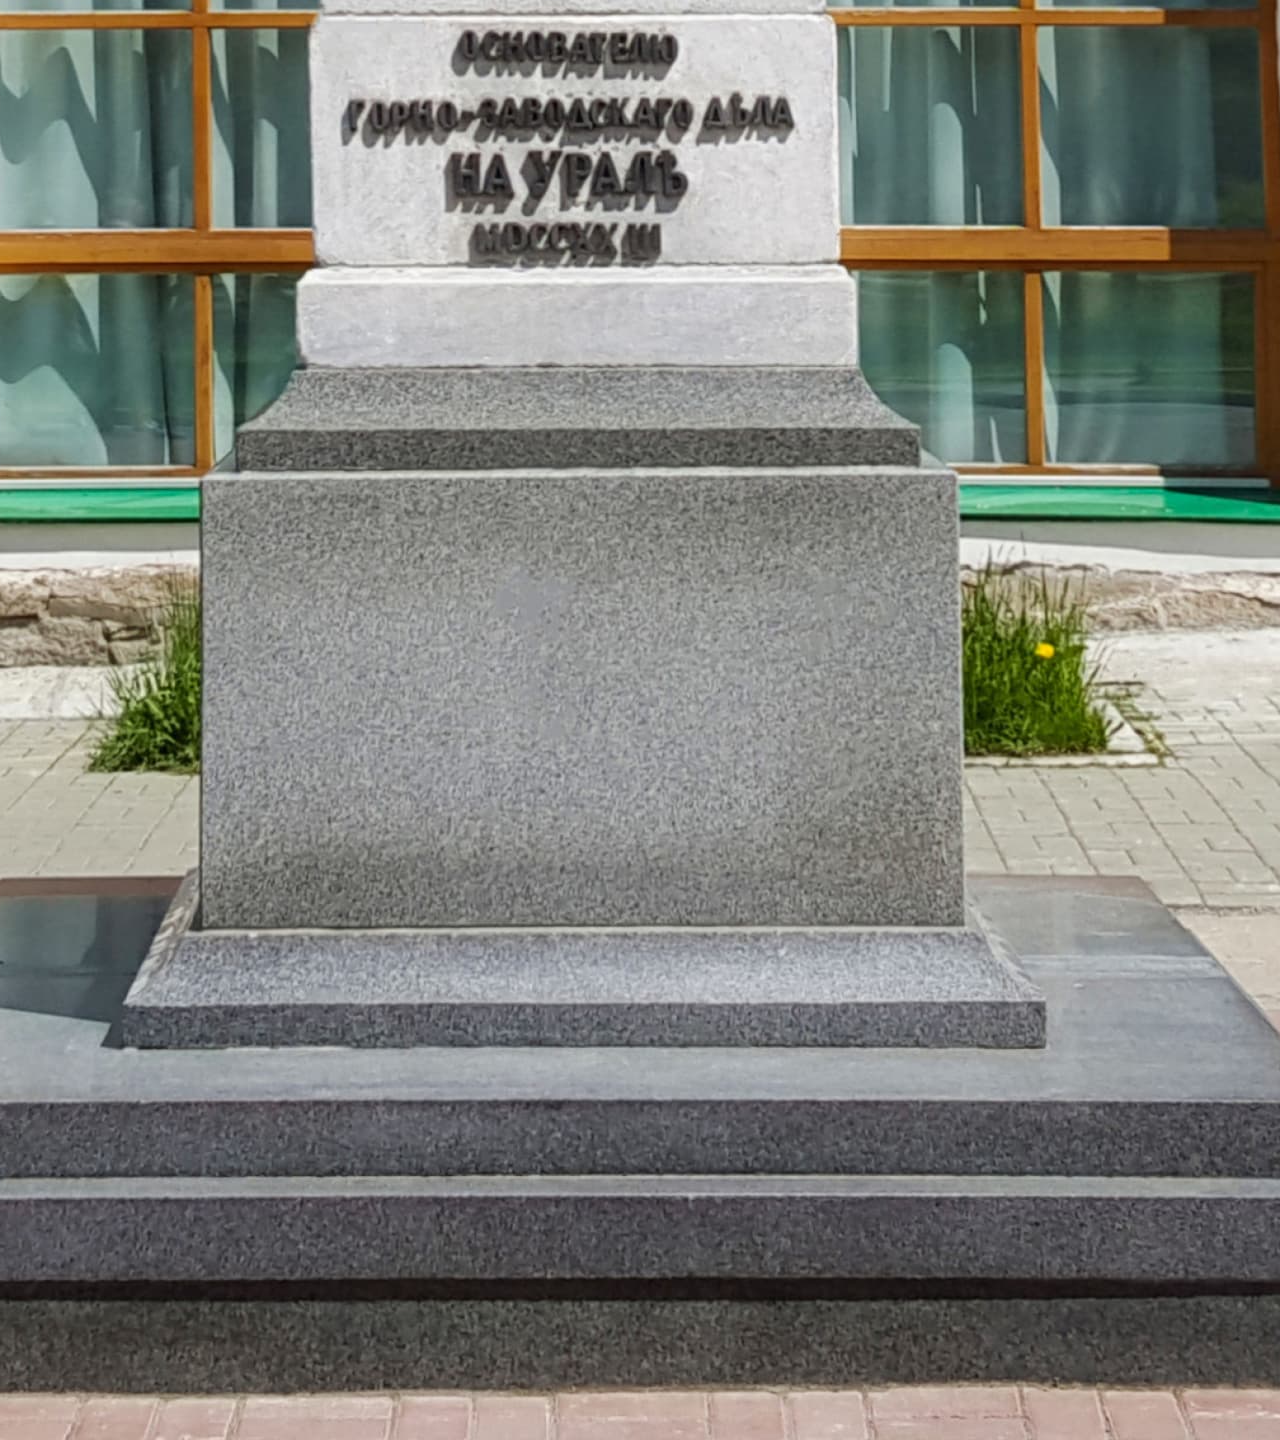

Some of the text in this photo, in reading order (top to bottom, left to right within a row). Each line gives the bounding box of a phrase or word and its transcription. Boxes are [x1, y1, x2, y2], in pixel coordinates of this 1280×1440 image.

[458, 30, 679, 65] ОСНОВАТЕЛЮ
[347, 96, 694, 132] ГОРНО-ЗАВОДСКАГО
[451, 152, 515, 197] НА
